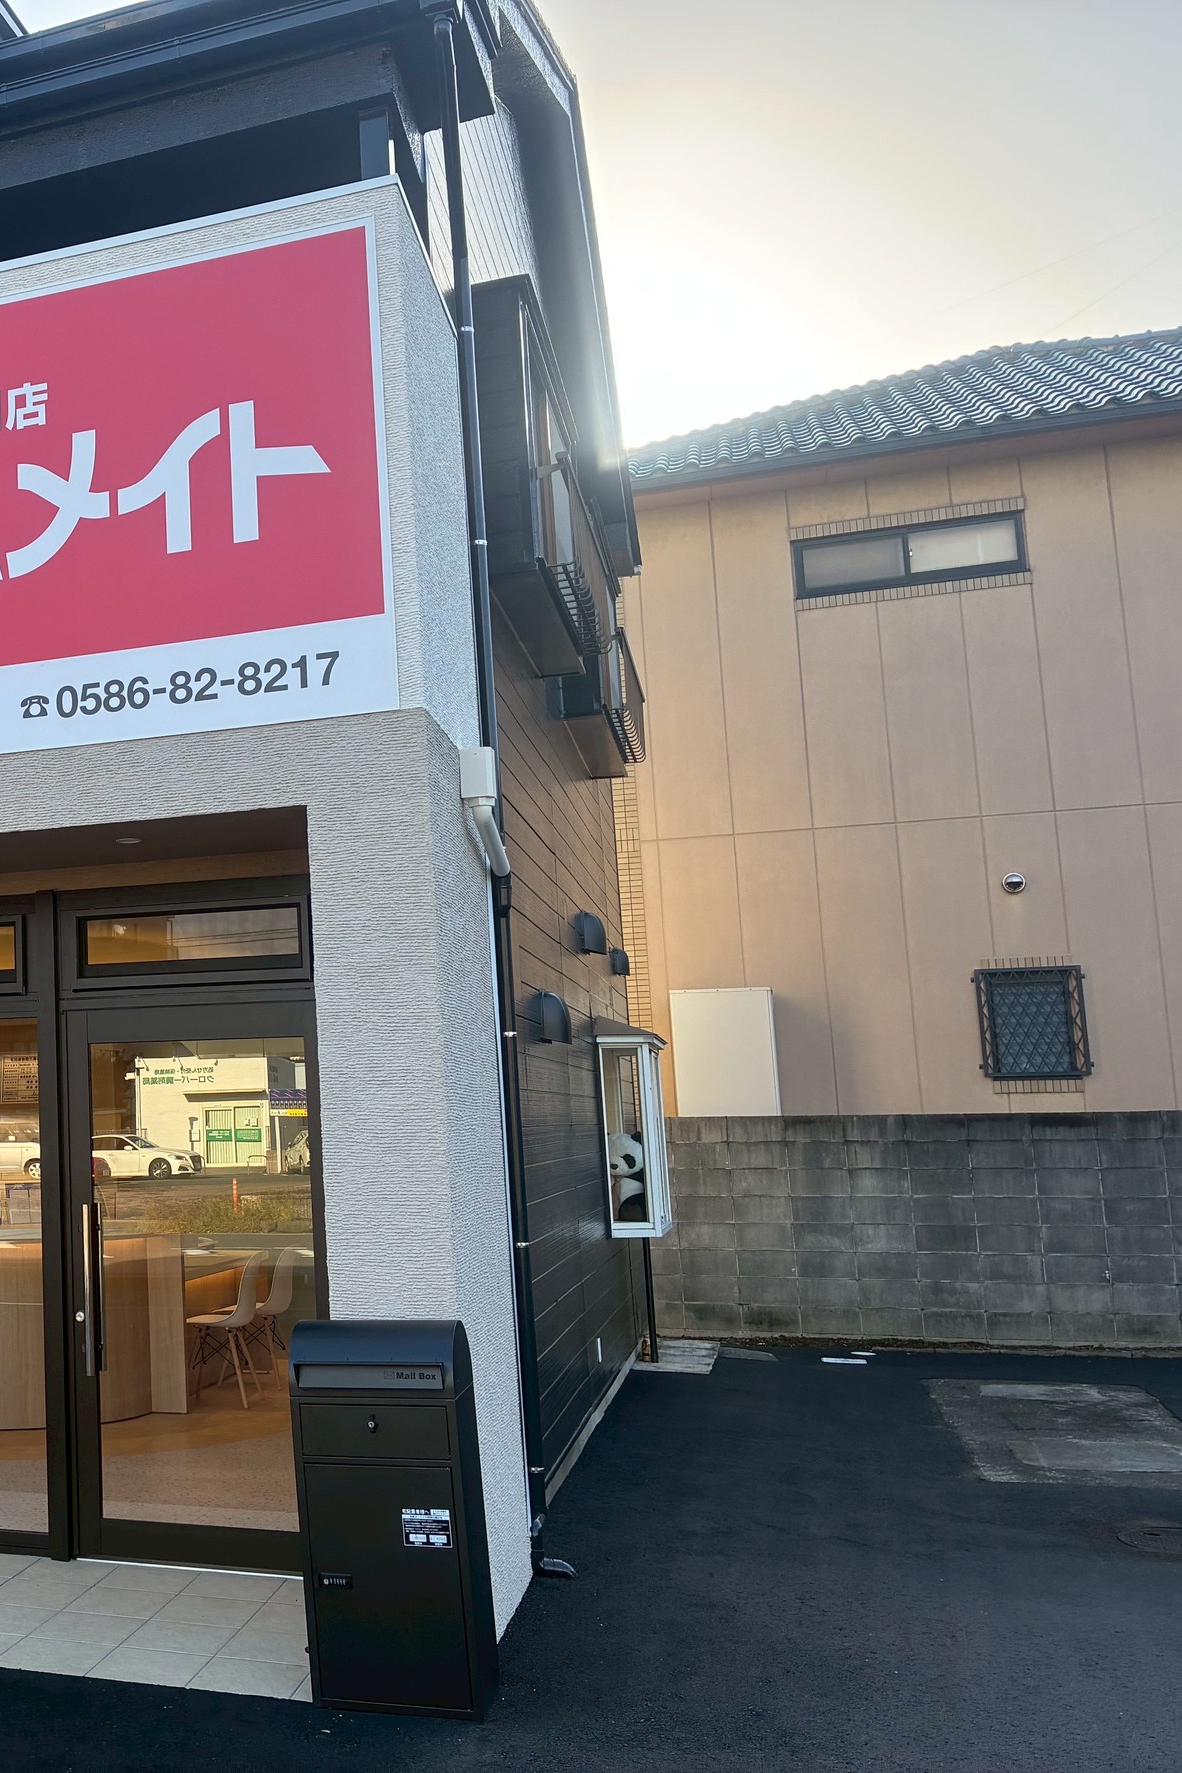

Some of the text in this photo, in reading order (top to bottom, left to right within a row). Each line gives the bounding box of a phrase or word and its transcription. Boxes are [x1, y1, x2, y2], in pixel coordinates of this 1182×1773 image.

[57, 651, 341, 719] 0586-82-8217
[396, 1372, 437, 1380] Mail Box
